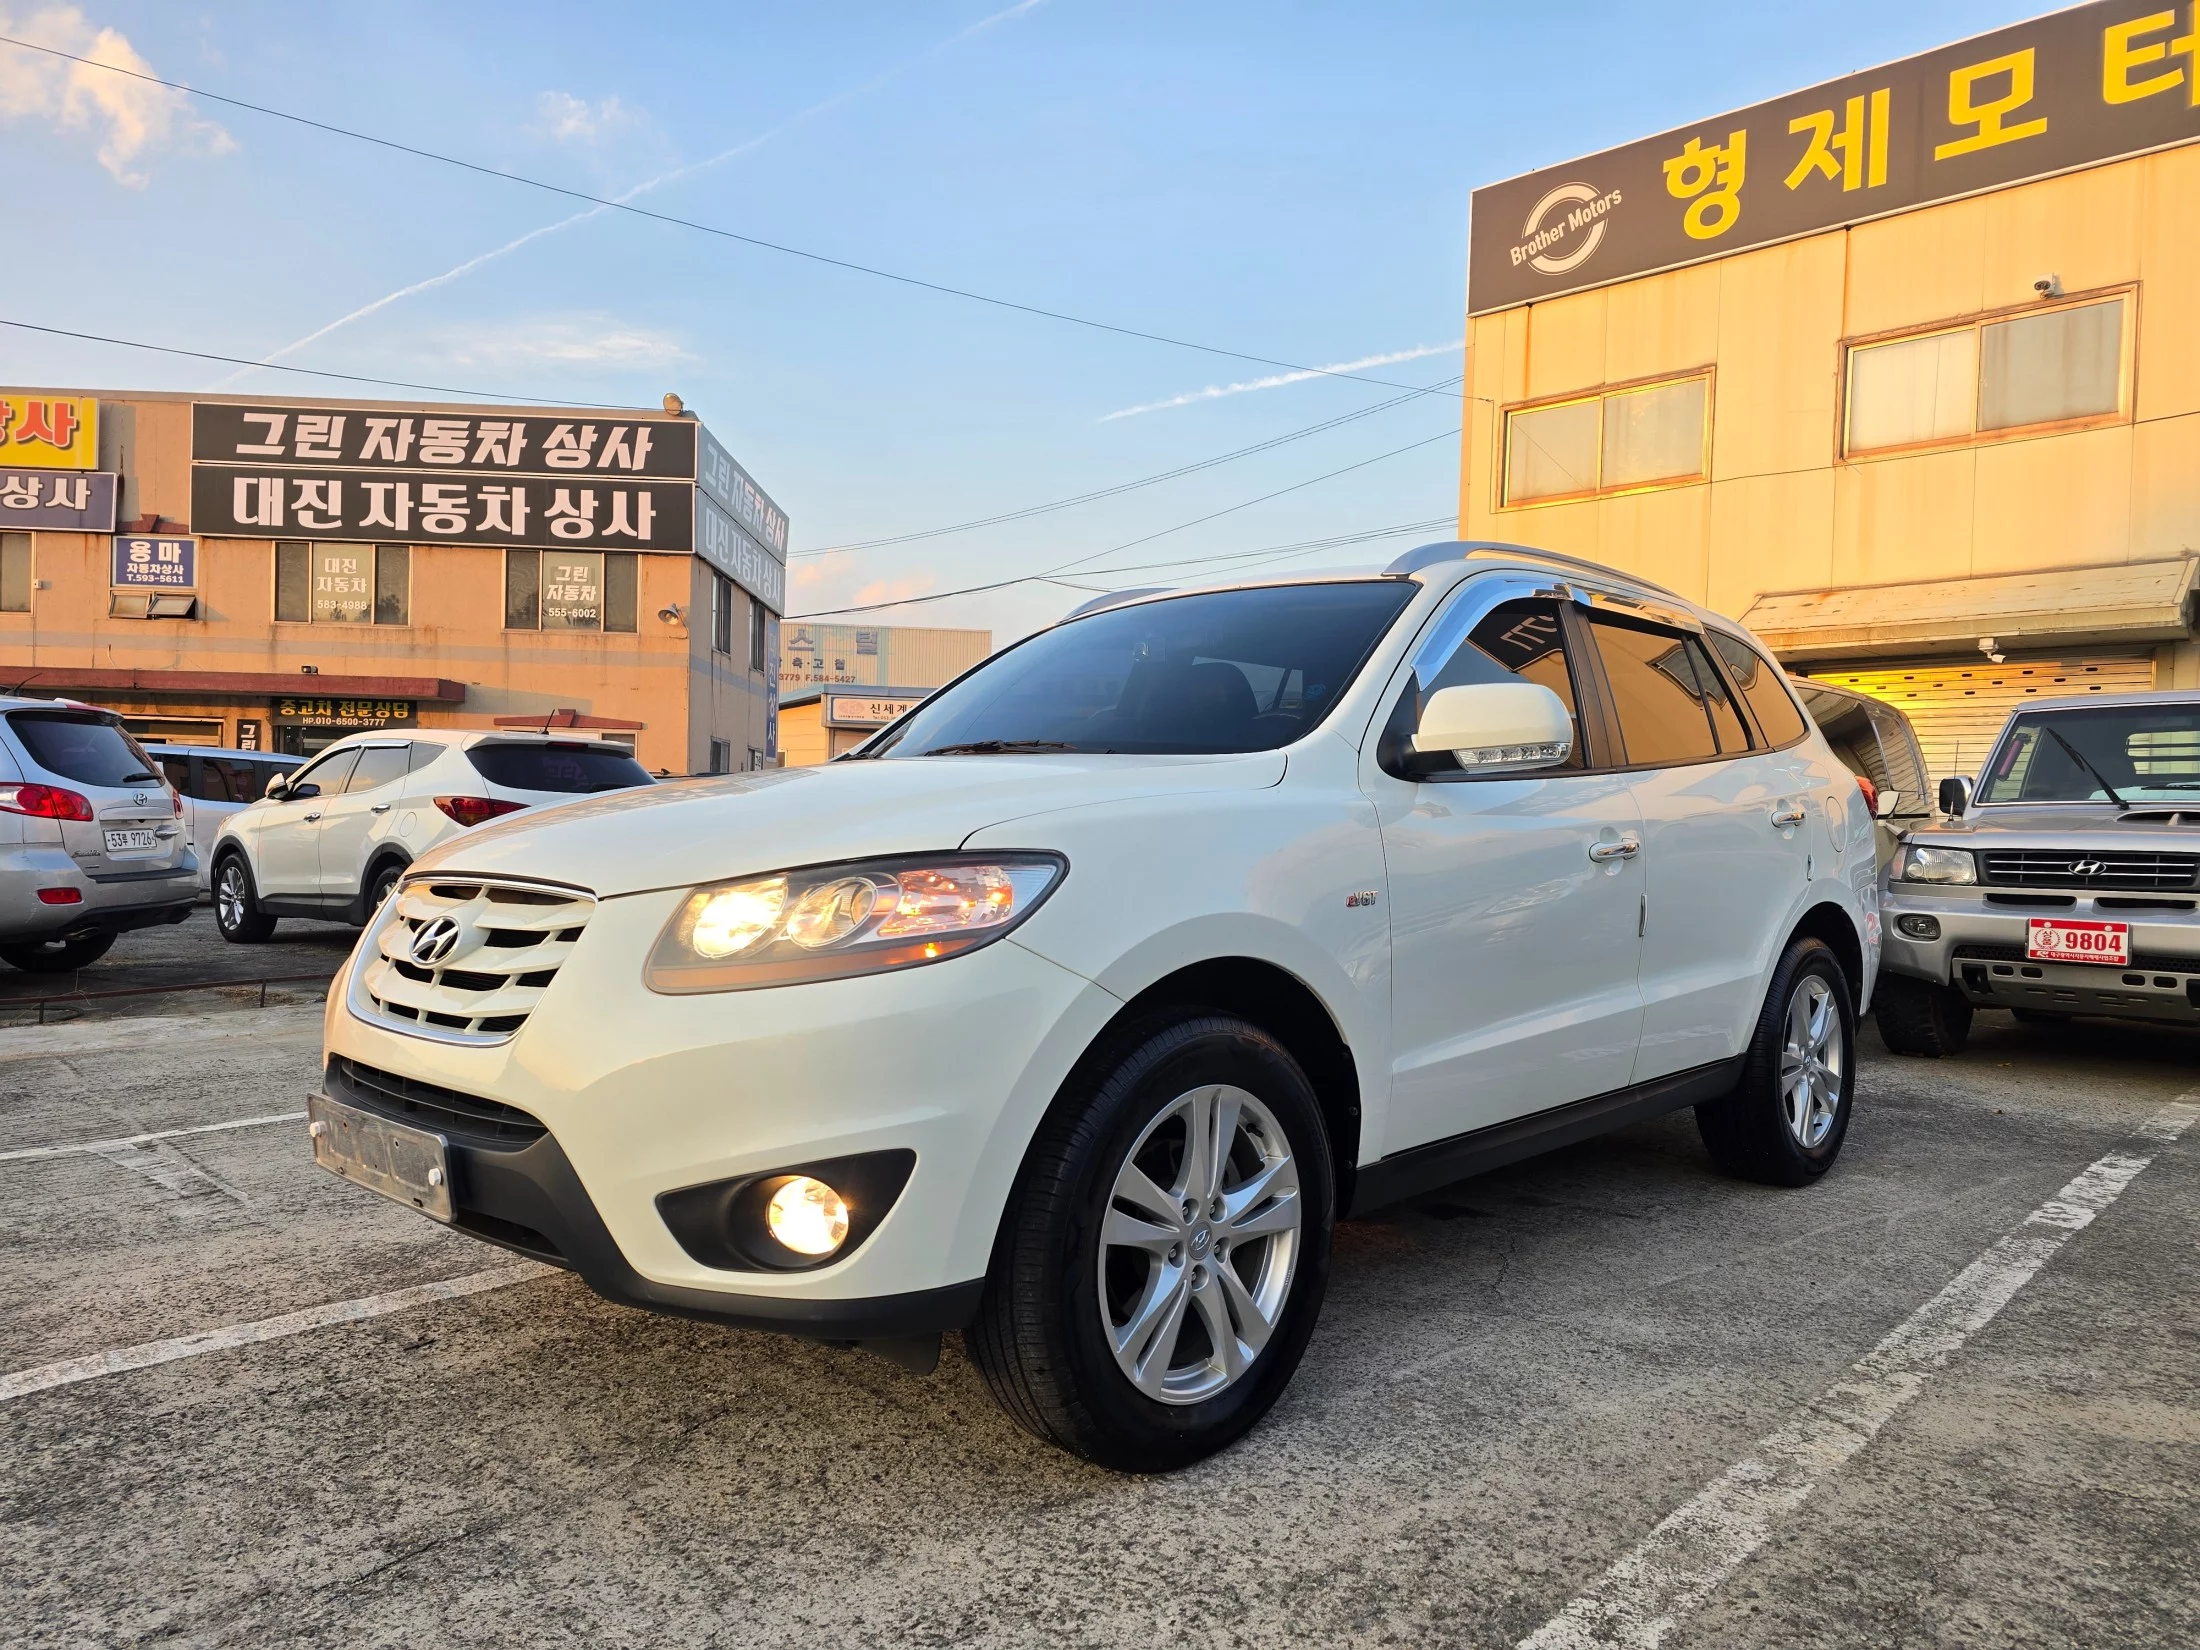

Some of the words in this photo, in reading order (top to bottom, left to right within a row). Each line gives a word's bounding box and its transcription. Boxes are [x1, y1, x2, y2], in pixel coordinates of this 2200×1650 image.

[1510, 222, 1565, 266] Brother
[1568, 189, 1622, 232] Motors
[235, 412, 347, 460] 그린
[358, 417, 528, 467] 자동차
[542, 424, 653, 471] 상사
[706, 443, 730, 500] 그린
[731, 470, 765, 533] 자동차
[765, 506, 785, 553] 상사
[232, 476, 343, 530] 대진
[358, 481, 531, 536] 자동차
[543, 488, 657, 541] 상사
[705, 507, 729, 564] 대진
[730, 529, 762, 590] 자동차
[763, 557, 781, 605] 상사
[126, 563, 184, 575] 자동차상사
[324, 558, 357, 574] 대진
[555, 566, 589, 582] 그린
[126, 574, 184, 583] T.593-5611
[316, 576, 367, 593] 자동차
[546, 584, 597, 601] 자동차
[317, 600, 368, 610] 583-4988
[548, 608, 596, 618] 555-6002
[280, 699, 333, 716] 중고차
[339, 700, 410, 719] 전문상담
[302, 717, 386, 727] HP.010-6500-3777
[130, 832, 152, 846] 9726
[2065, 932, 2122, 952] 9804
